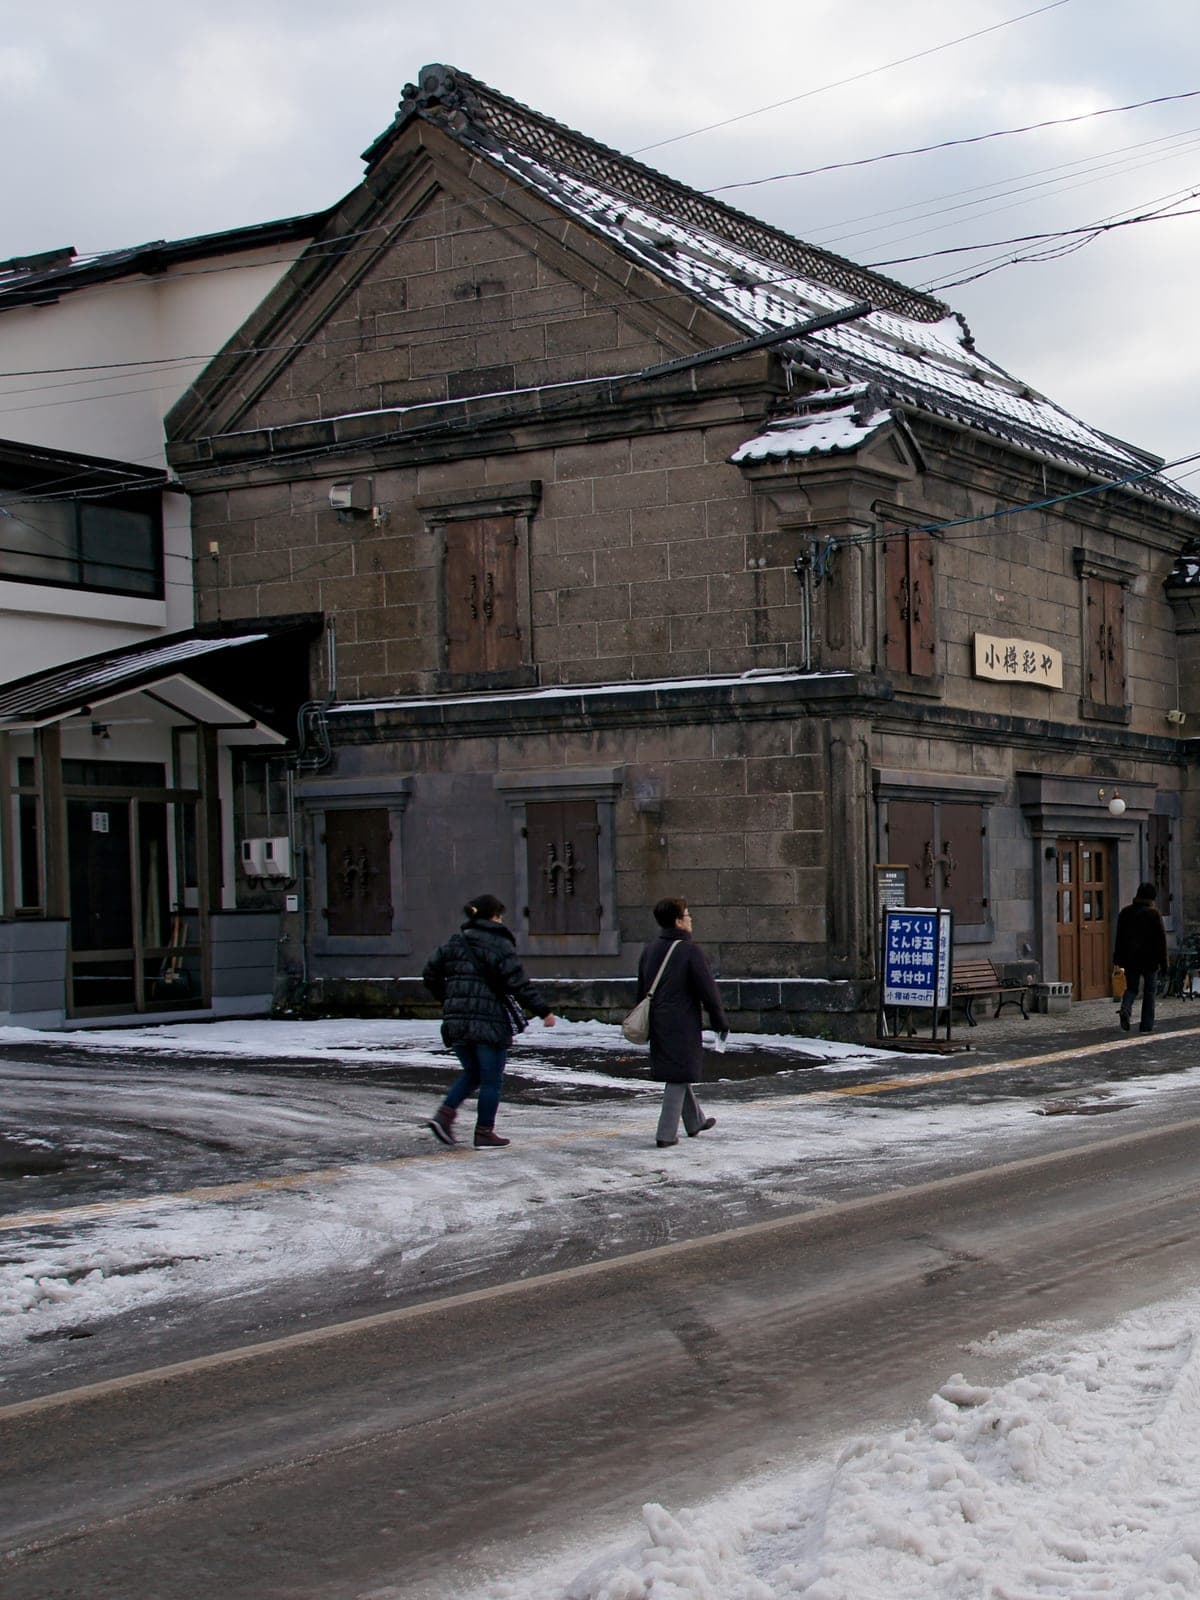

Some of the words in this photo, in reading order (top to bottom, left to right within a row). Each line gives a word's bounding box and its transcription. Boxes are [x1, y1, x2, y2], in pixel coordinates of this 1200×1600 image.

[984, 643, 1053, 677] 小樽彩や
[889, 919, 934, 934] 手づくり
[891, 936, 934, 950] とんぼ玉
[888, 950, 934, 966] 制作体験
[890, 970, 932, 985] 受付中!
